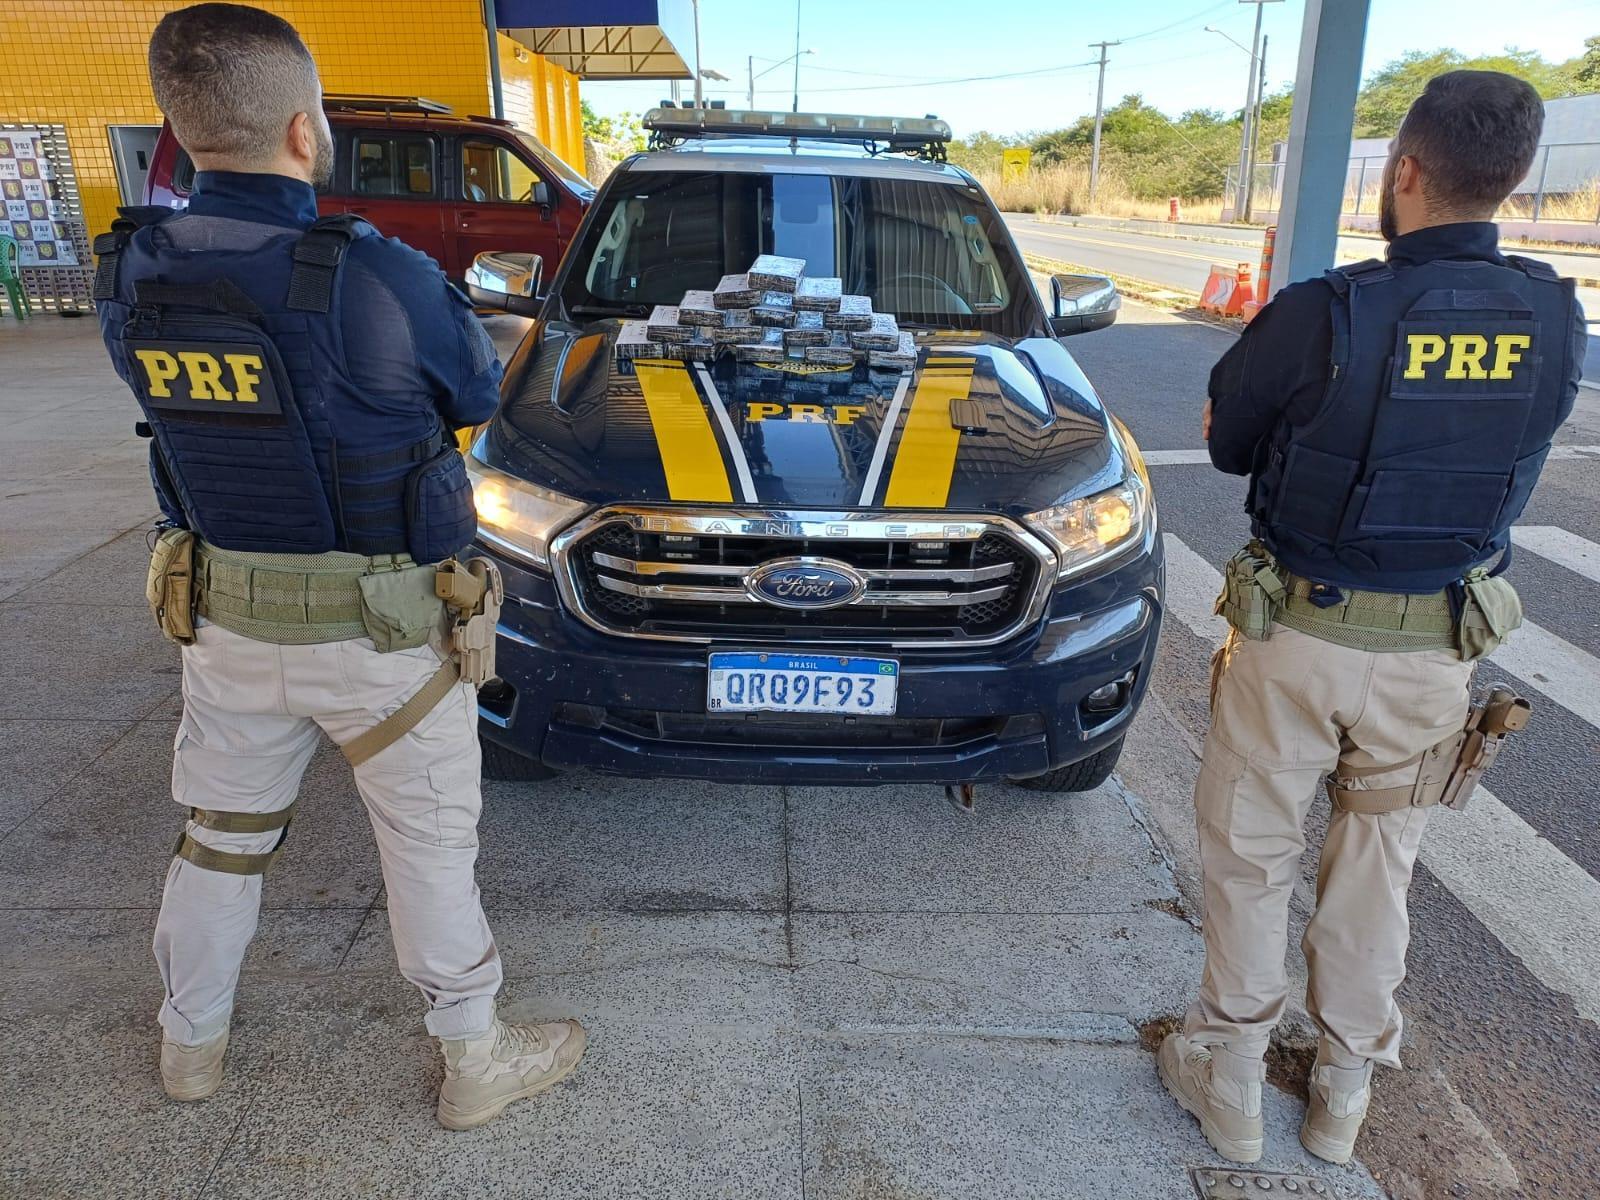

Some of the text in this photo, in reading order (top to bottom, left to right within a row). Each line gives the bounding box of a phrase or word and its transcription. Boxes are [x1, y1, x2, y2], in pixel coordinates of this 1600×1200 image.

[14, 142, 31, 150] PRF
[25, 184, 41, 192] PRF
[9, 204, 25, 212] PRF
[1403, 334, 1531, 380] PRF
[134, 350, 264, 403] PRF
[746, 402, 867, 425] PRF
[647, 517, 967, 538] RANGER
[775, 574, 834, 599] Ford
[788, 661, 819, 670] BRASIL
[726, 672, 877, 708] QRQ9F93
[711, 698, 722, 709] BR
